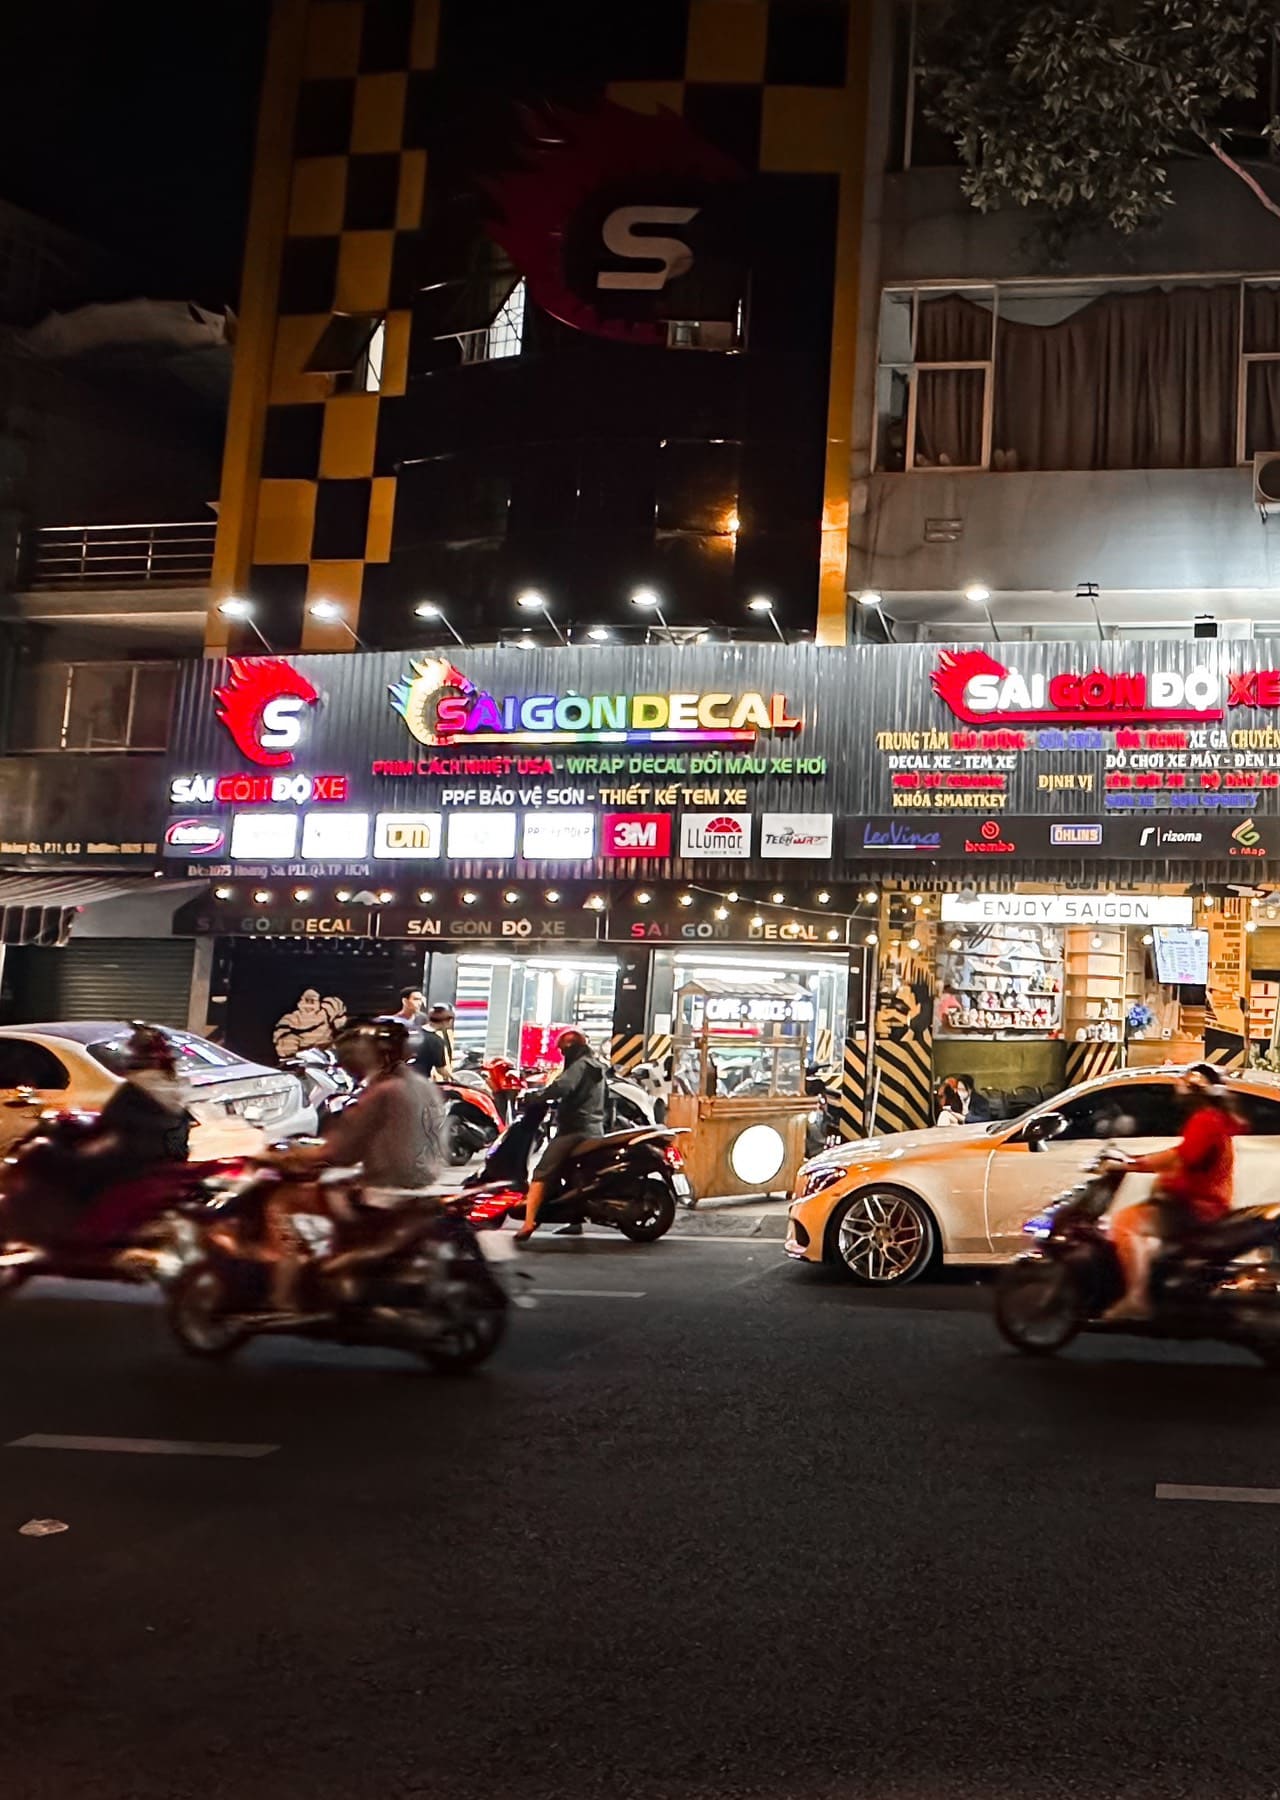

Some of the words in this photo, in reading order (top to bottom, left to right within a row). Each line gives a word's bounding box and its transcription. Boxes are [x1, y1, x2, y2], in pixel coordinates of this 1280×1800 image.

[967, 666, 1044, 710] SÀI
[877, 731, 920, 750] TRUNG
[922, 727, 950, 750] TÂM
[1189, 729, 1207, 749] XE
[1210, 729, 1228, 749] GA
[517, 759, 553, 775] USA
[567, 758, 624, 775] WRAP
[629, 758, 686, 775] DECAL
[725, 755, 766, 775] MÀU
[770, 758, 792, 774] XE
[889, 755, 930, 769] DECAL
[934, 755, 951, 769] XE
[963, 755, 994, 769] TEM
[997, 755, 1016, 769] XE
[1167, 754, 1186, 768] XE
[1190, 751, 1221, 767] MÁY
[170, 774, 214, 803] SÀI
[313, 775, 348, 801] XE
[442, 789, 476, 805] PPF
[682, 789, 719, 805] TEM
[724, 789, 747, 805] XE
[893, 790, 932, 807] KHÓA
[935, 793, 1008, 808] SMARTKEY
[613, 821, 657, 847] 3M
[687, 828, 743, 849] LLumar
[863, 822, 941, 845] LeoVince
[1162, 829, 1202, 843] rizoma
[965, 840, 1016, 853] brembo
[984, 900, 1051, 916] ENJOY
[1065, 901, 1149, 918] SAIGON
[407, 917, 441, 935] SÀI
[450, 917, 492, 935] GÒN
[541, 920, 565, 935] XE
